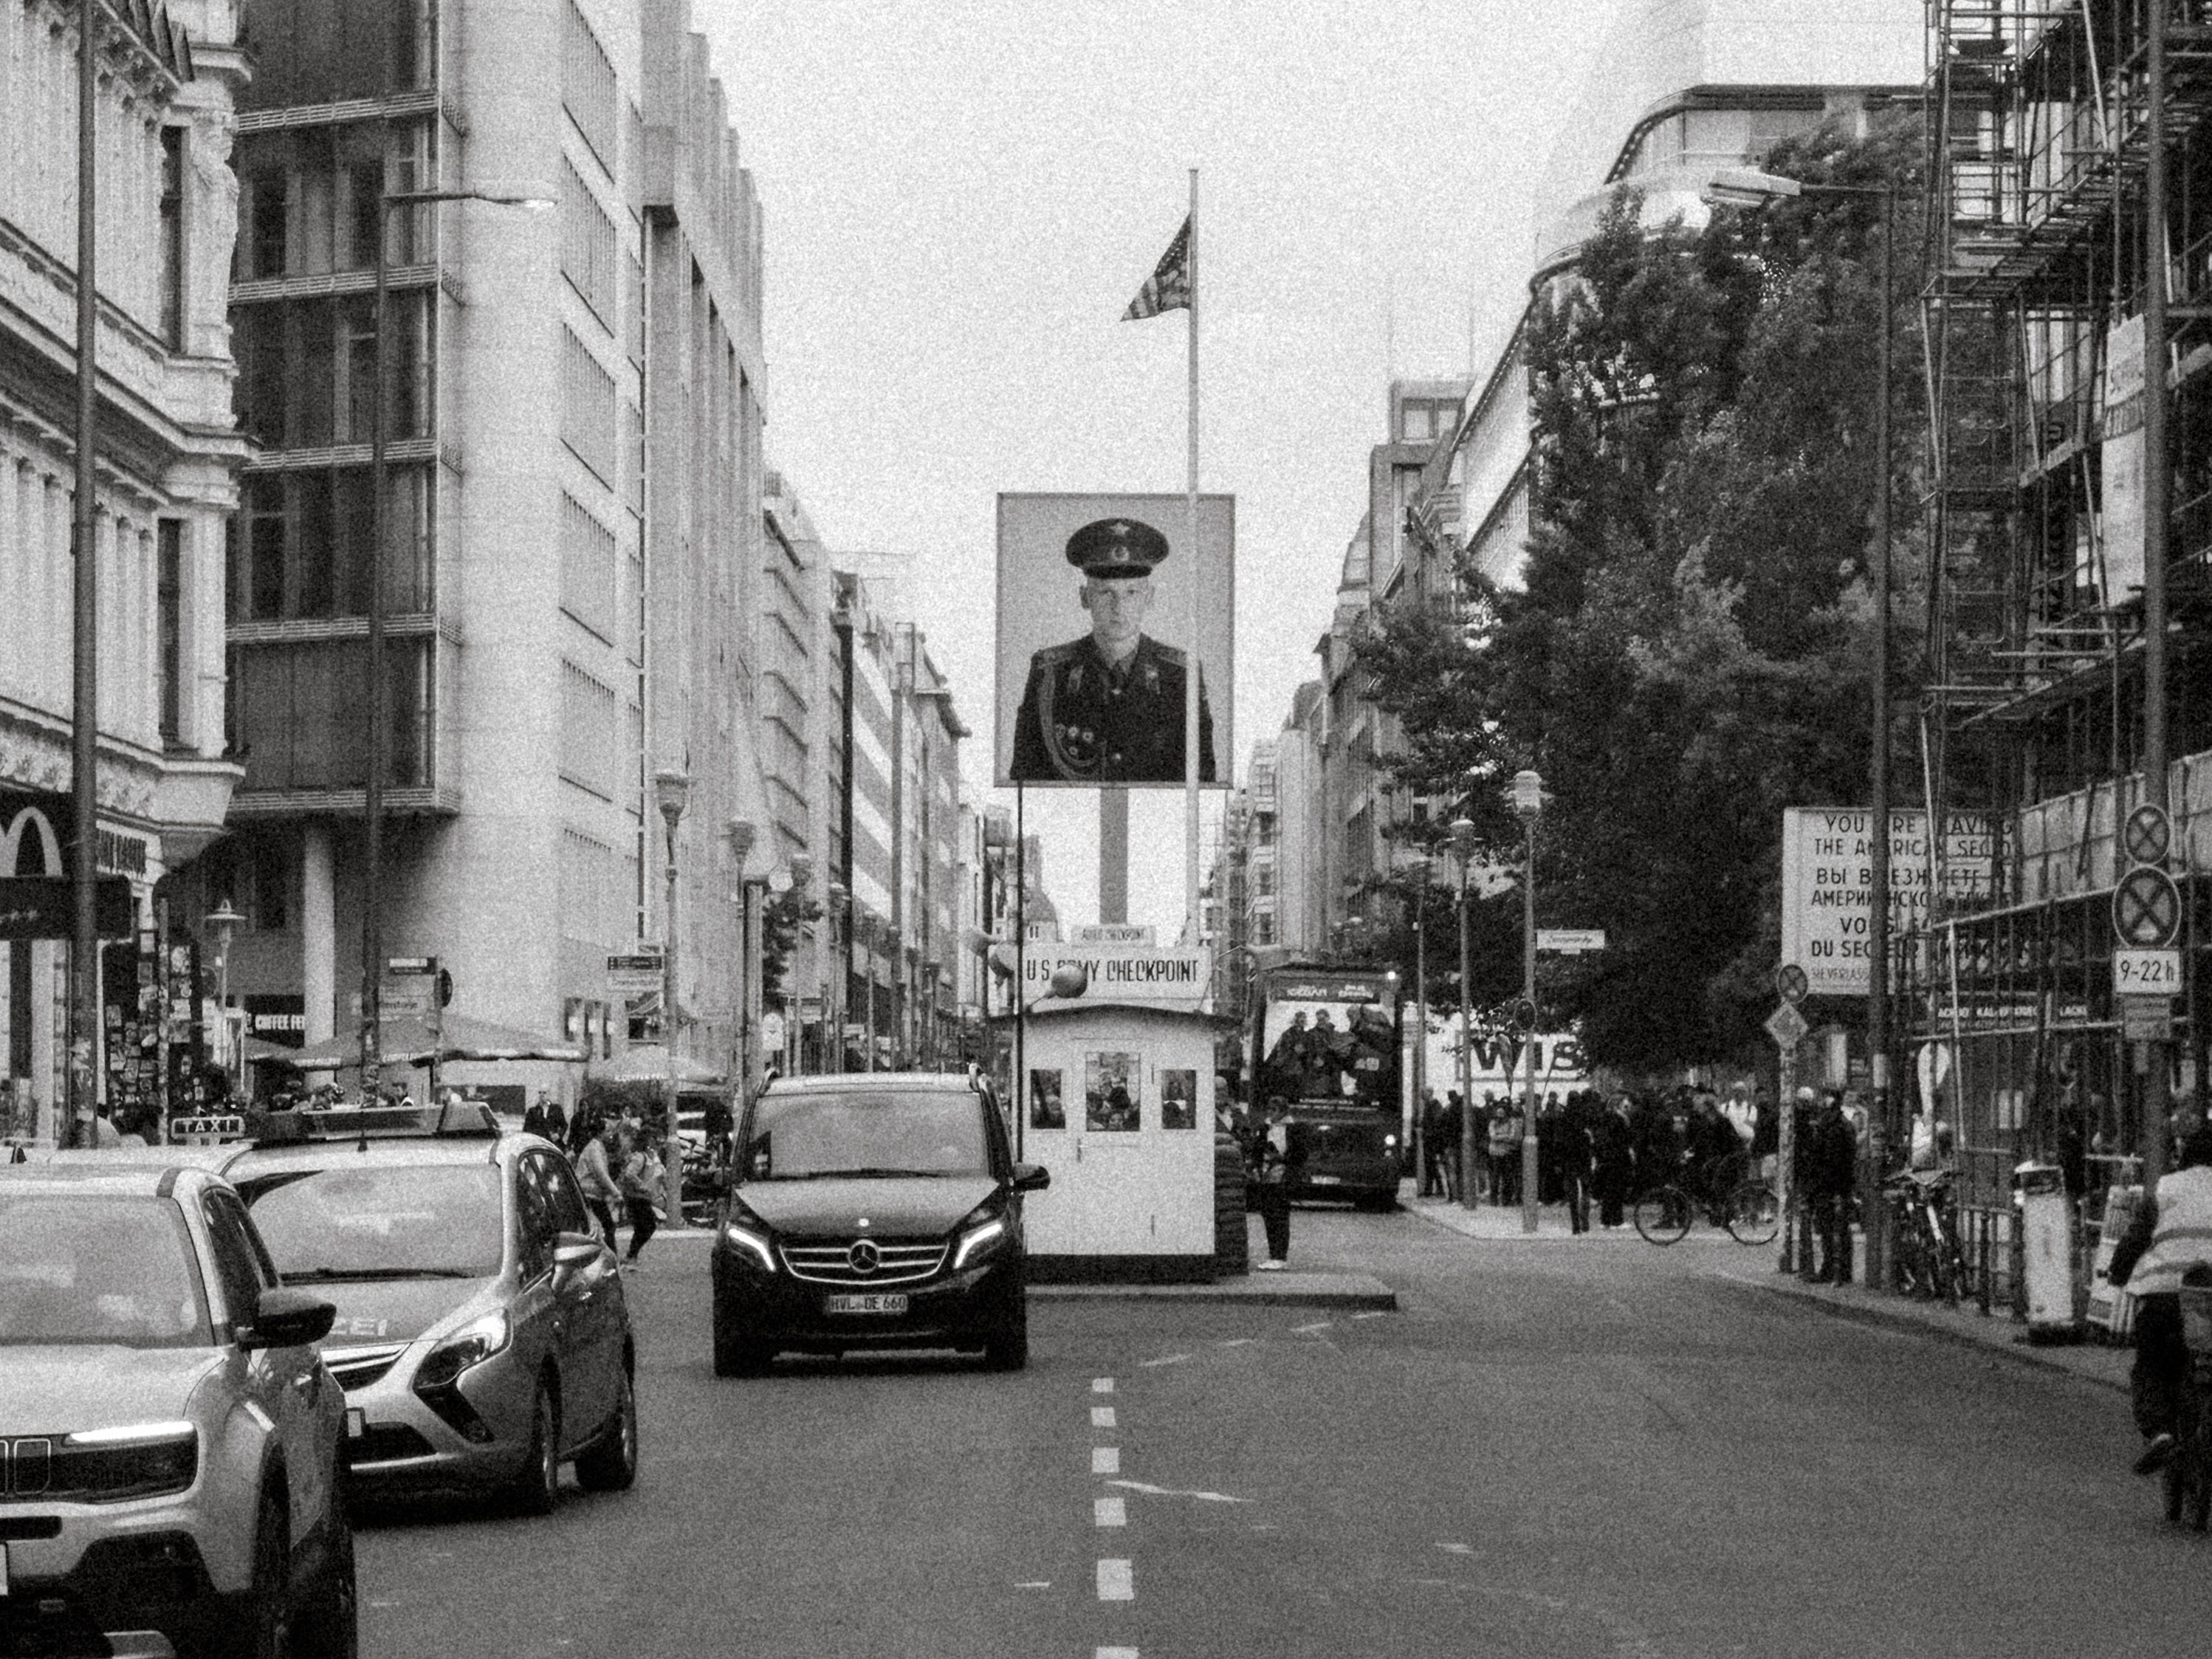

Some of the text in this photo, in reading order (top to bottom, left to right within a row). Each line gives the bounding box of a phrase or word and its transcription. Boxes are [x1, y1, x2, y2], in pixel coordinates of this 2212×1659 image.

[1826, 815, 1864, 833] YOU
[1815, 839, 1844, 855] THE
[1812, 940, 1833, 957] DU
[1107, 960, 1198, 981] CHECKPOINT
[182, 1120, 230, 1133] TAXI
